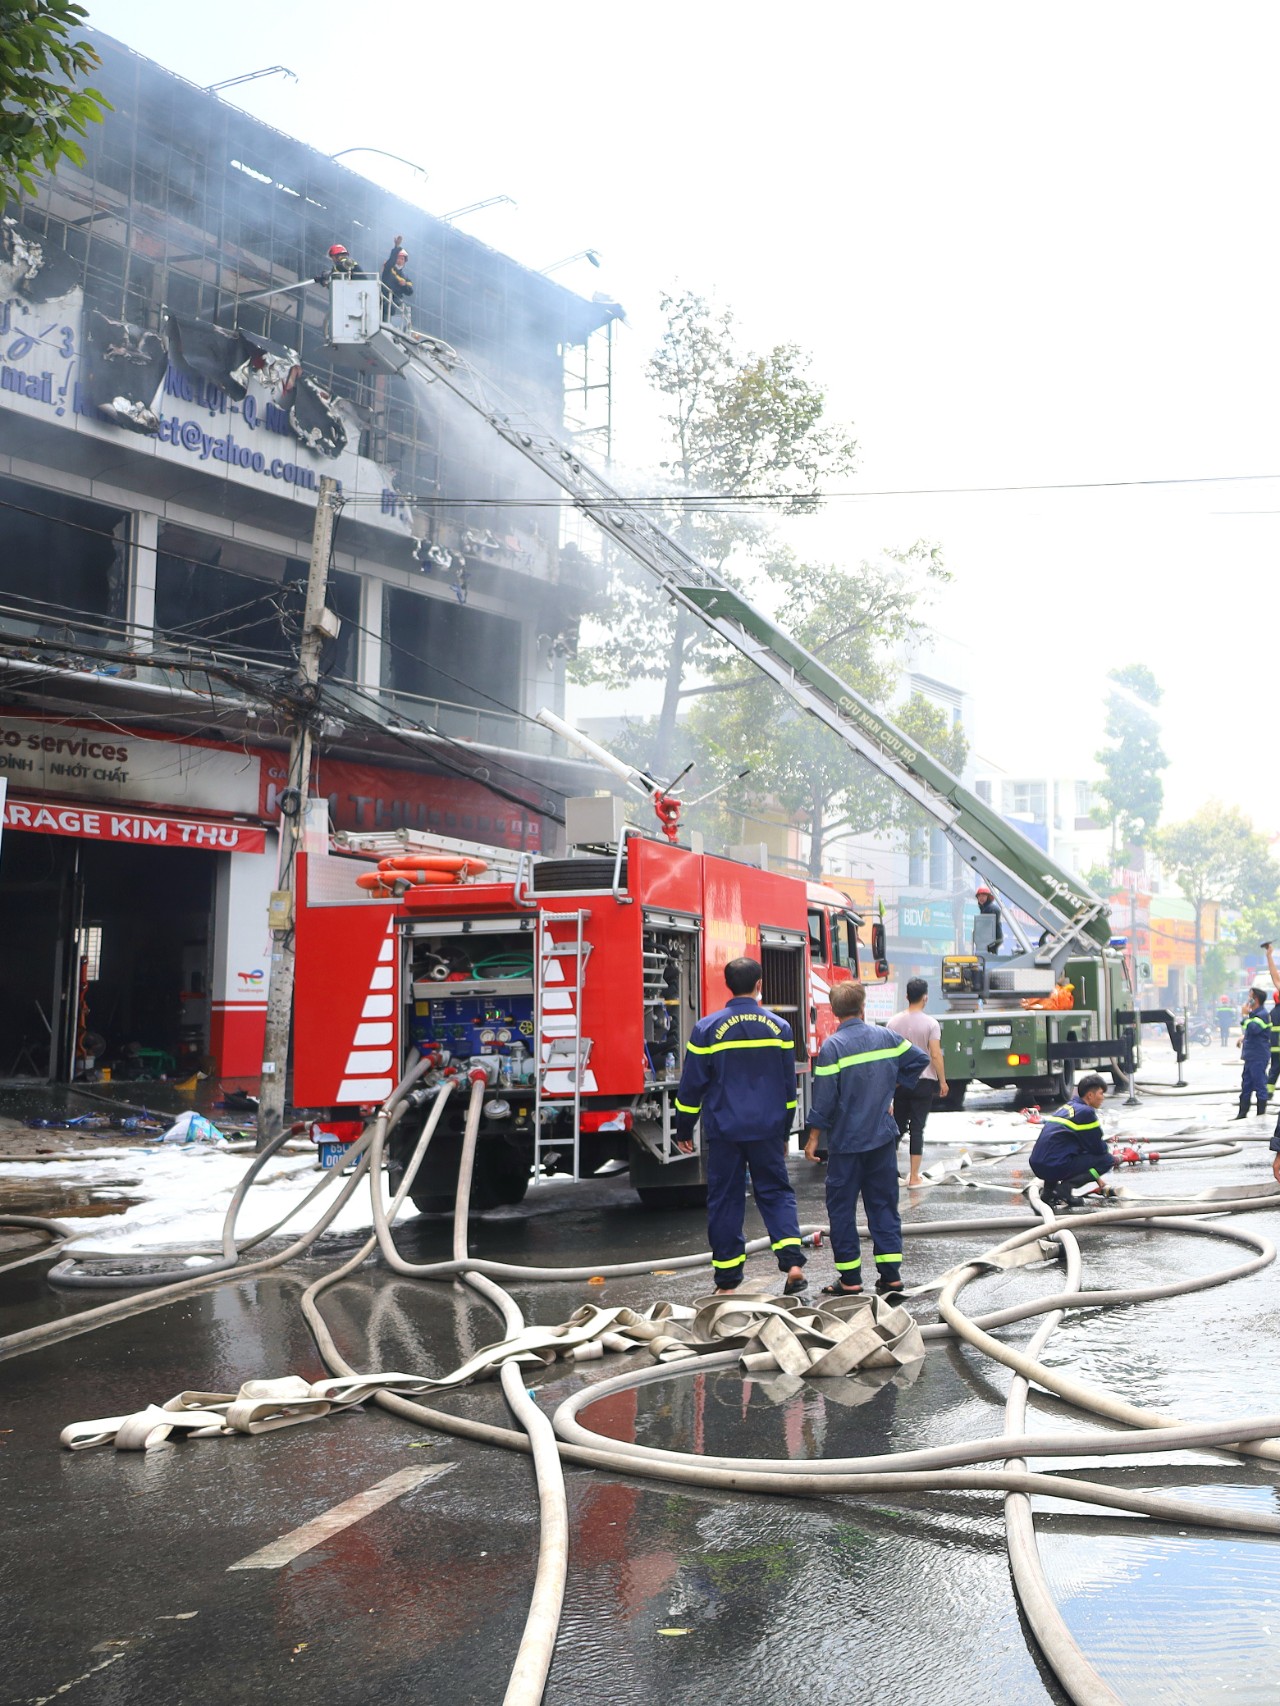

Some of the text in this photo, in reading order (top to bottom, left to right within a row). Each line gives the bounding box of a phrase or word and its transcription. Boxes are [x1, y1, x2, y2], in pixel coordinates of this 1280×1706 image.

[28, 734, 128, 762] services
[50, 761, 90, 779] NHỚT
[93, 764, 129, 783] CHẤT
[111, 817, 168, 841] KIM
[177, 824, 239, 847] THU
[903, 908, 924, 926] BIDV
